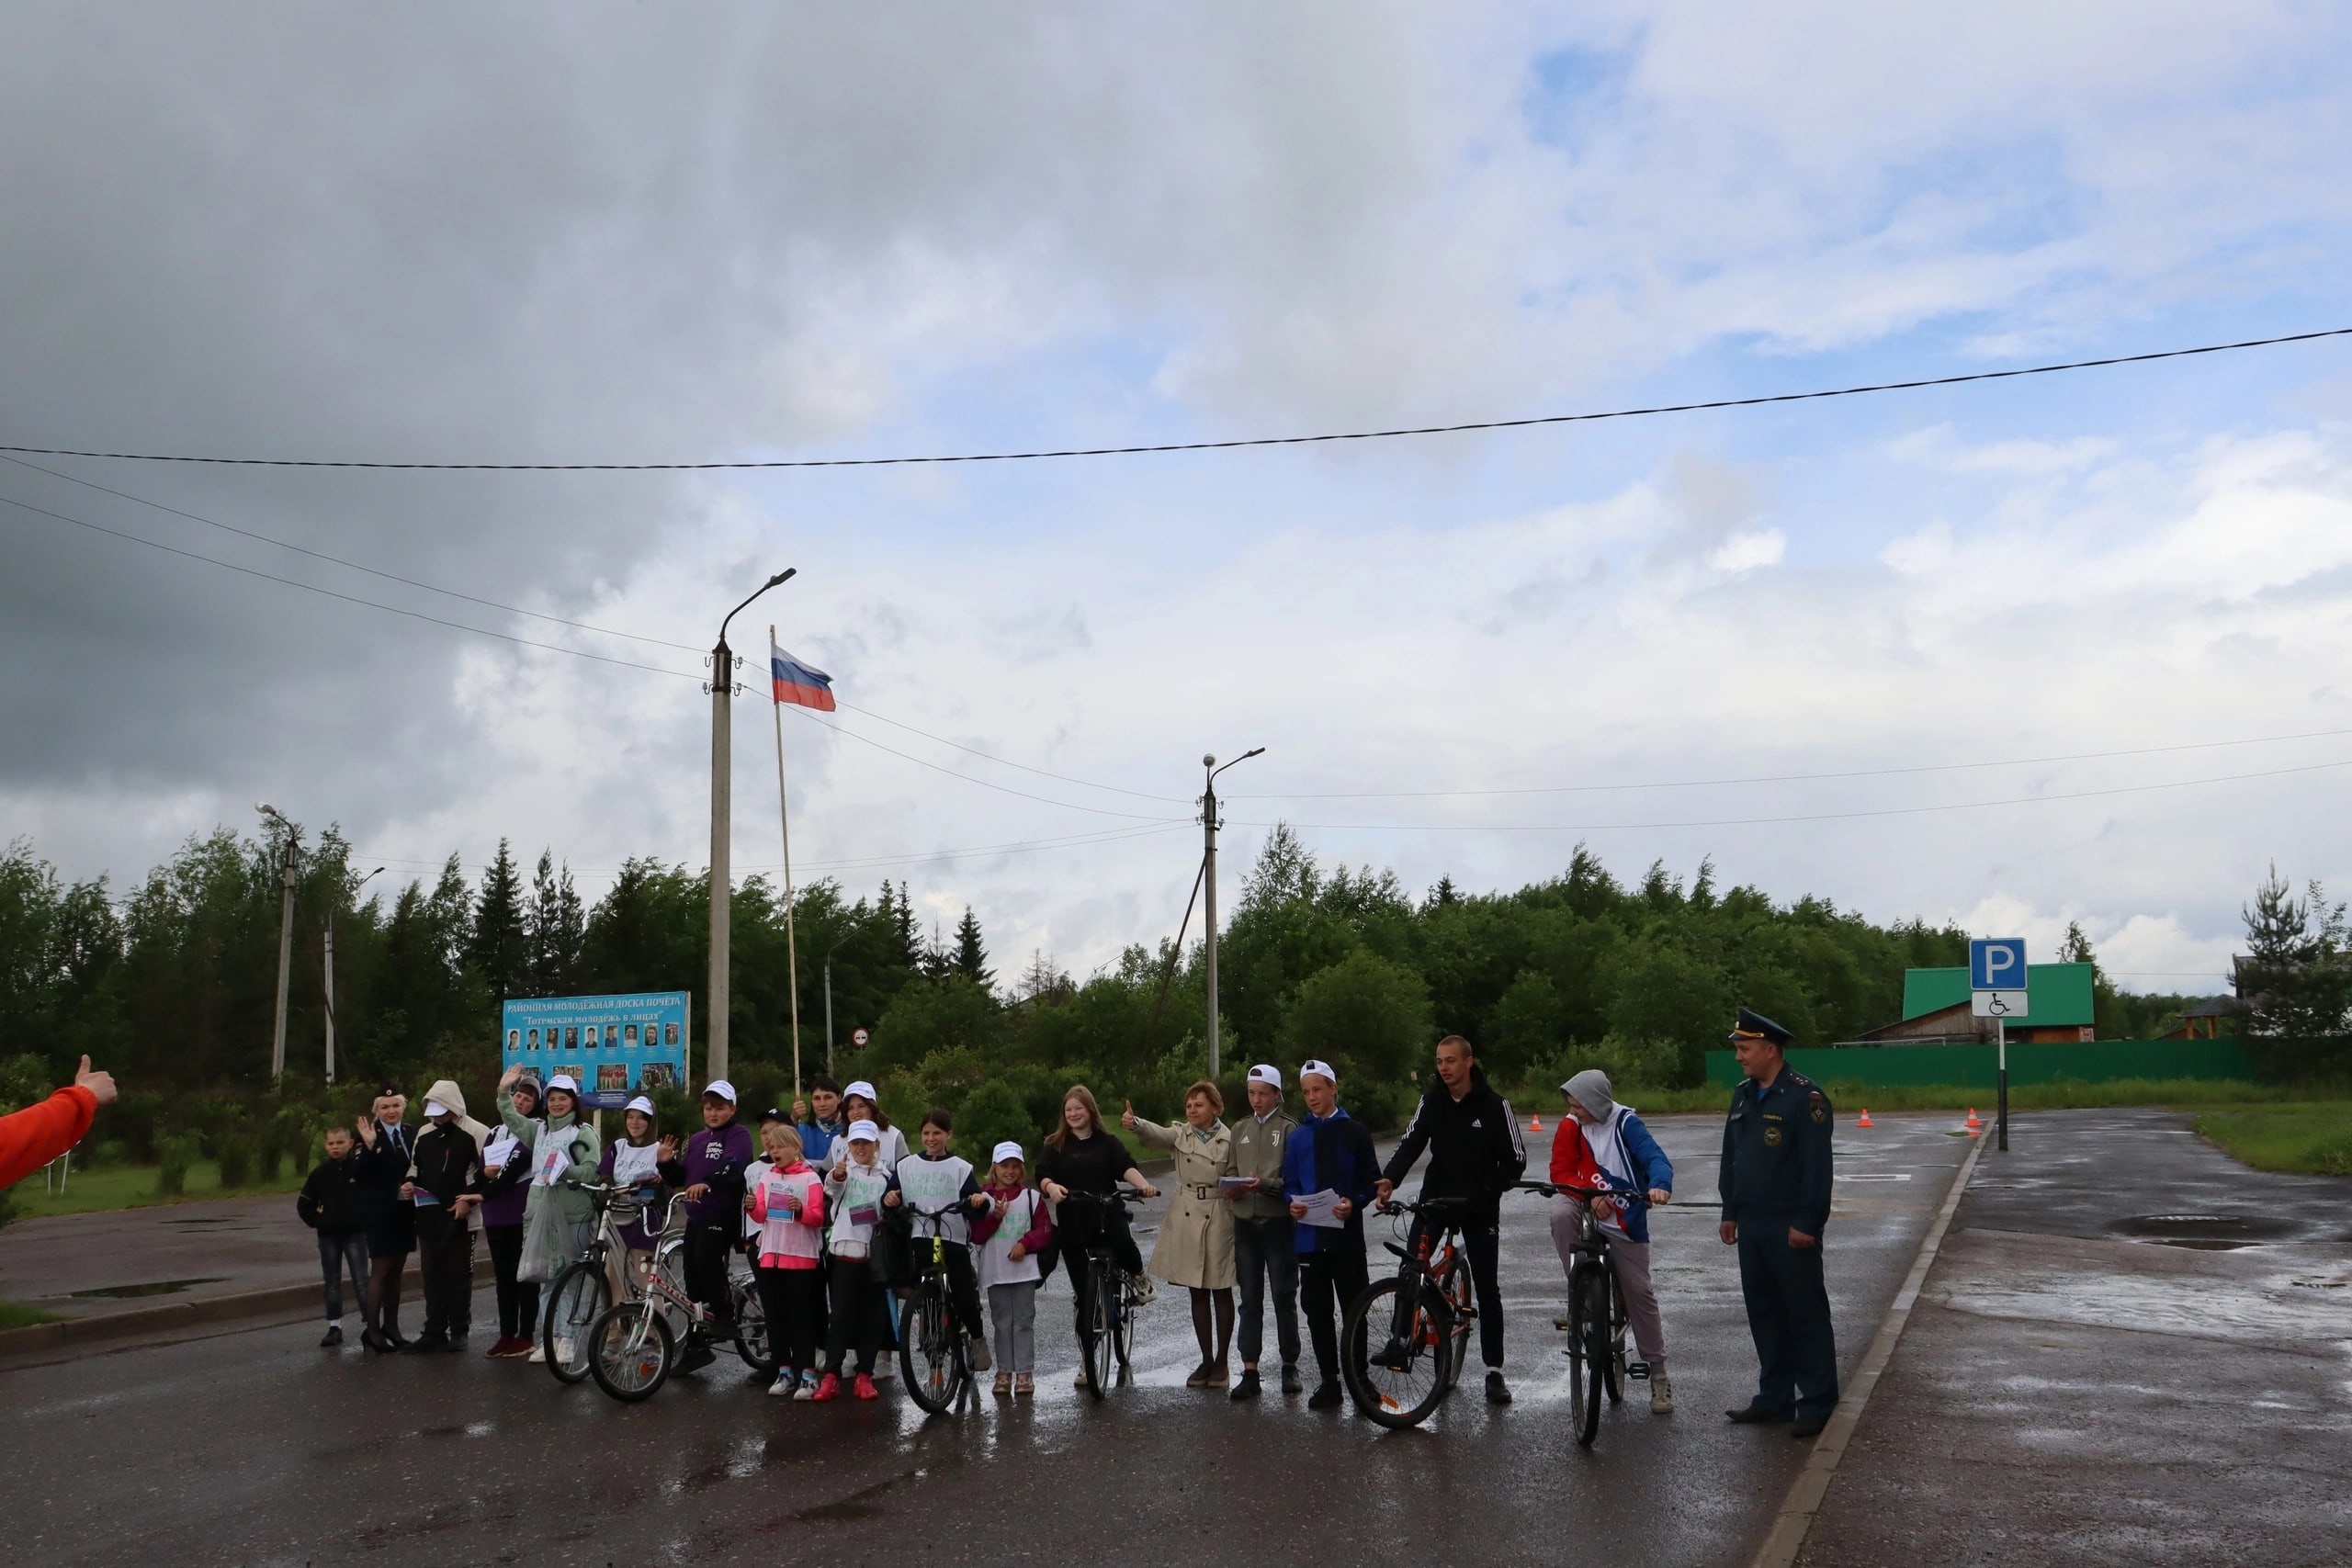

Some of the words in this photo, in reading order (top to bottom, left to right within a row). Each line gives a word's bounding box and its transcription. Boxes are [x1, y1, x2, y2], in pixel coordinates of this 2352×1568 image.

[1985, 945, 2015, 984] P
[507, 1003, 552, 1013] РАЙОННАЯ
[554, 999, 614, 1011] МОЛОДЁЖНАЯ
[615, 999, 644, 1010] ДОСКА
[646, 996, 681, 1007] ПОЧЁТА
[575, 1013, 621, 1023] молодёжь
